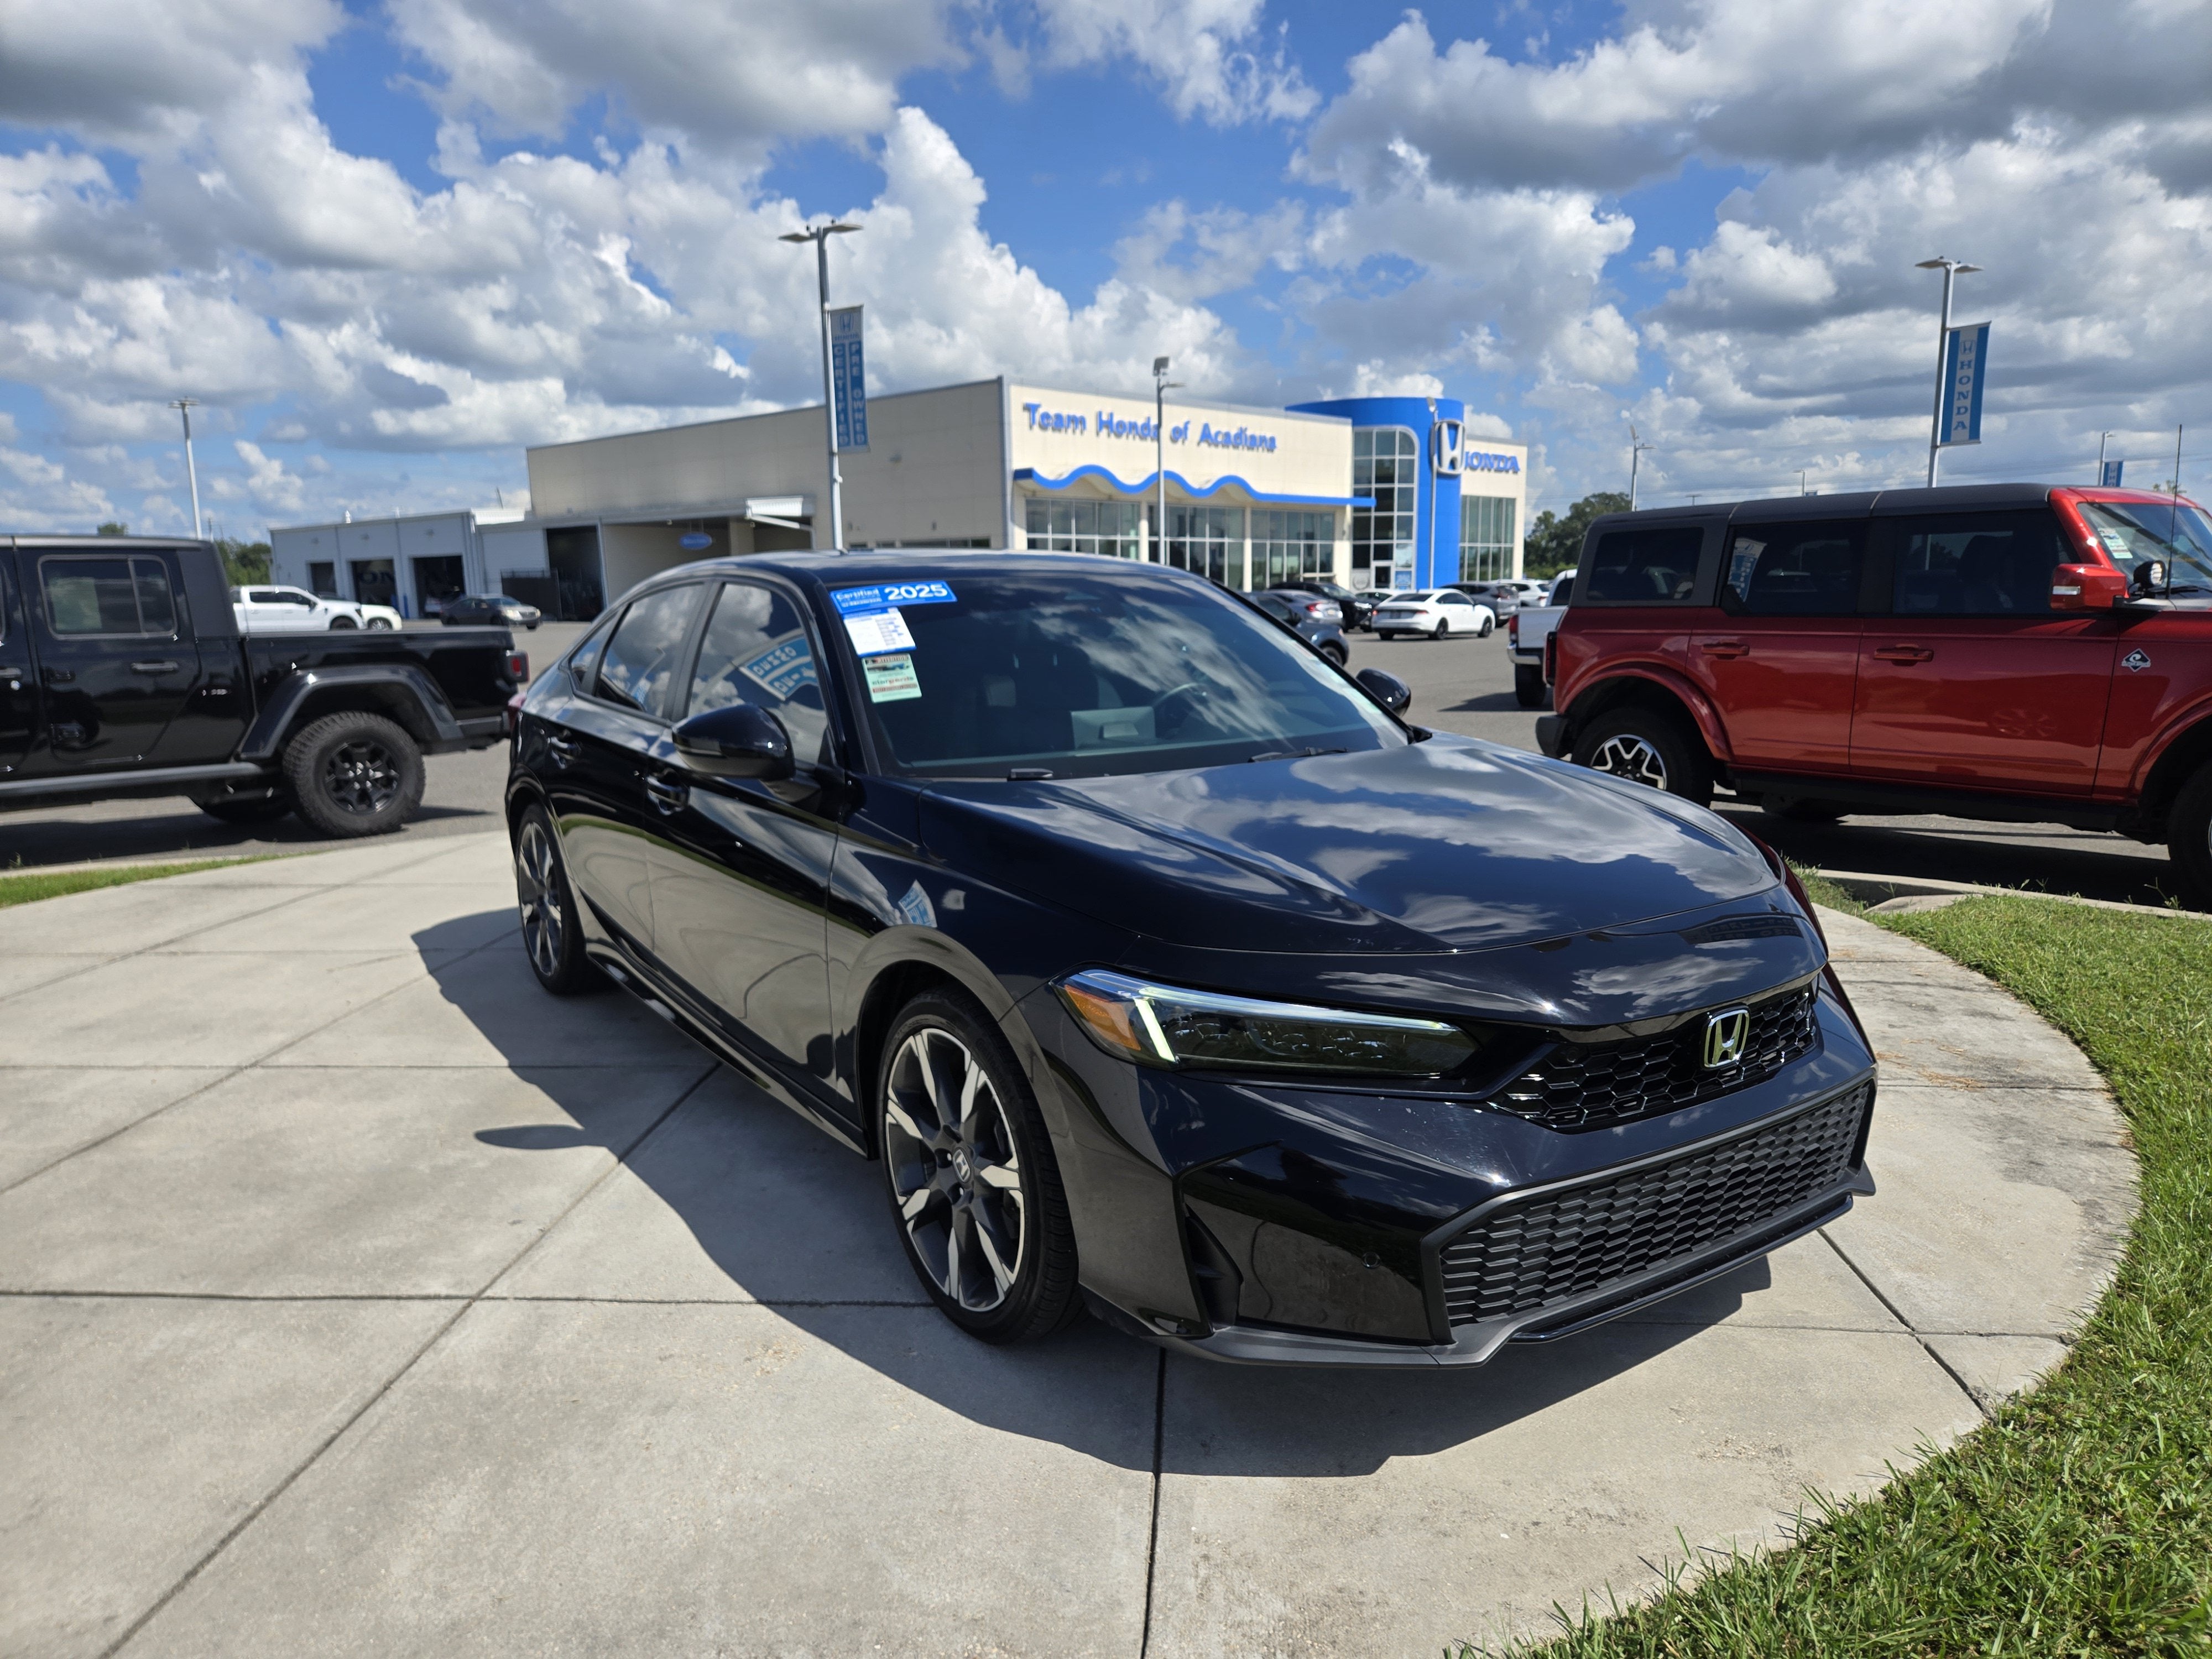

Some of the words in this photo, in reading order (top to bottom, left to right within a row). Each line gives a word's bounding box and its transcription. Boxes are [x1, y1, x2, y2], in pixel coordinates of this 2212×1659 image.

[1953, 359, 1972, 431] HONDA
[1024, 402, 1087, 432] Team
[1171, 420, 1190, 441] of
[1199, 422, 1277, 451] Acadiana
[884, 584, 948, 601] 2025
